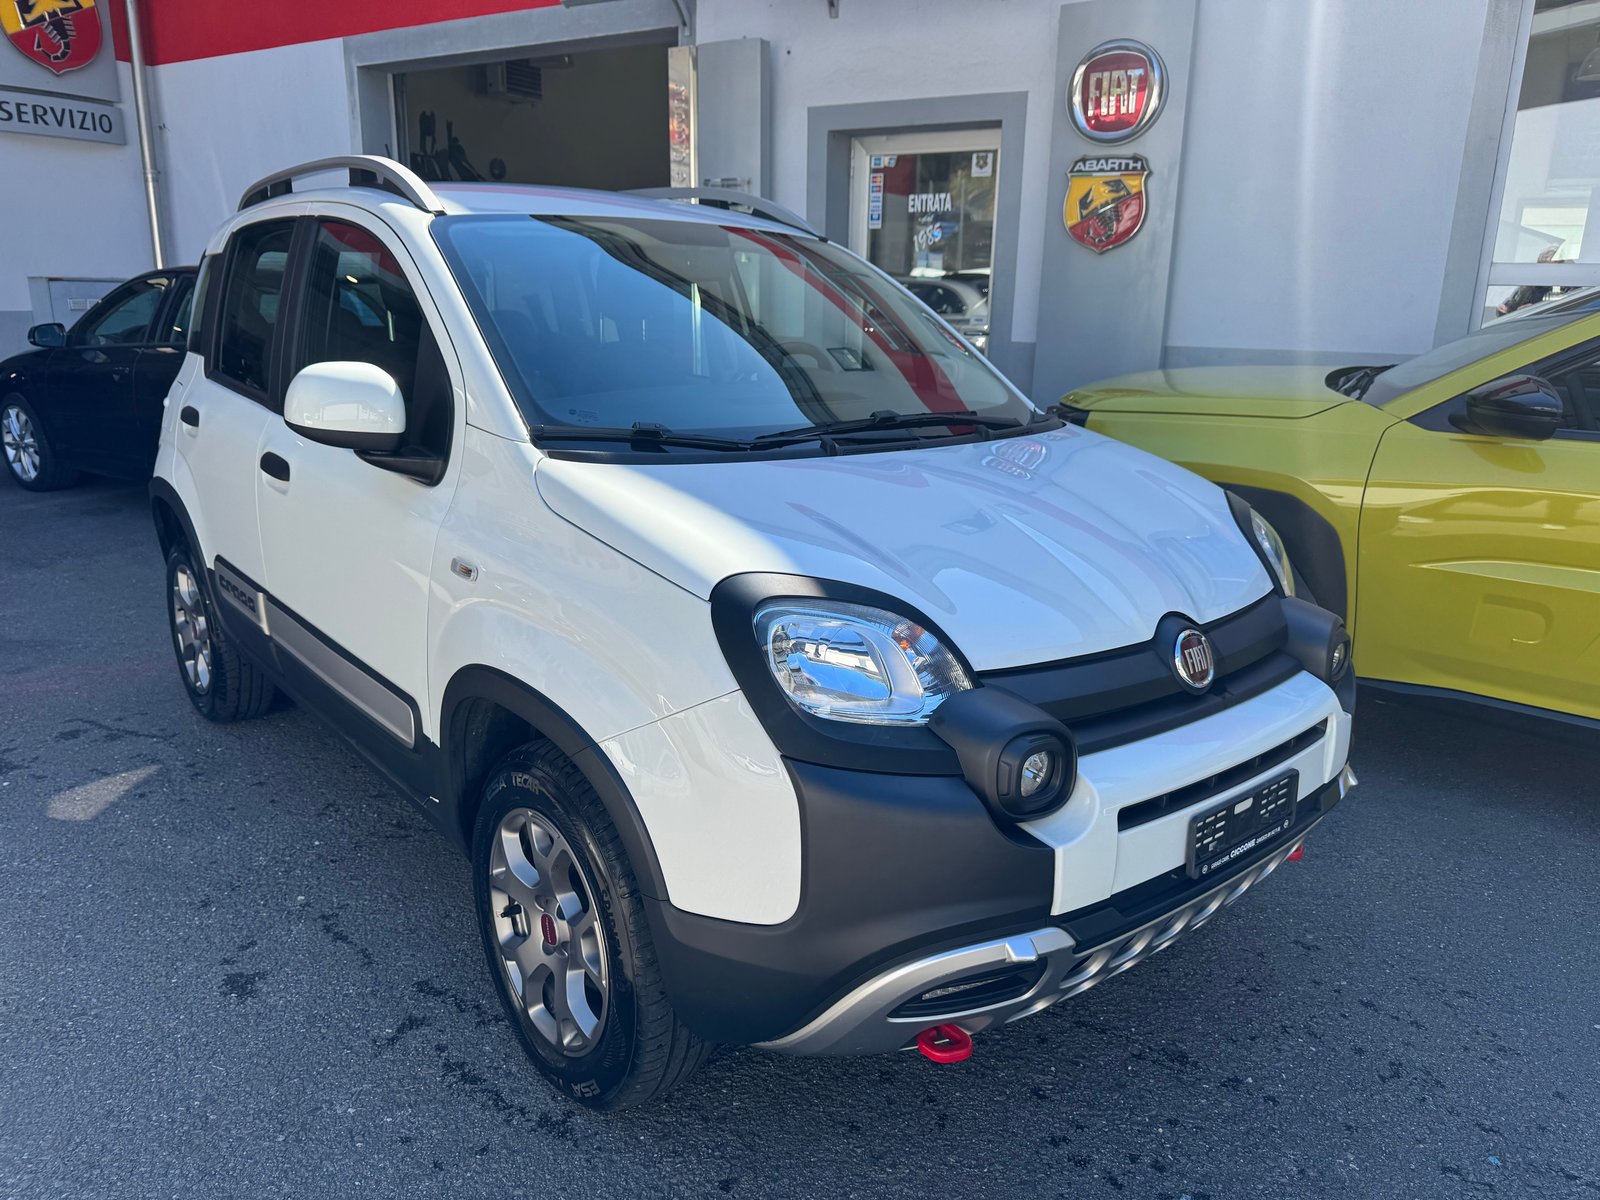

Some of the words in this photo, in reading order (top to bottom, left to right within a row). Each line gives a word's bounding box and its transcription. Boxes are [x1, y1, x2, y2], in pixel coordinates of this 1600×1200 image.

[1087, 68, 1144, 117] FIAT
[0, 100, 113, 134] SERVIZIO
[1073, 158, 1142, 172] ABARTH
[908, 192, 952, 213] ENTRATA
[1184, 645, 1208, 675] FIAT
[511, 771, 539, 795] TECAR
[1230, 838, 1256, 858] CICCONE
